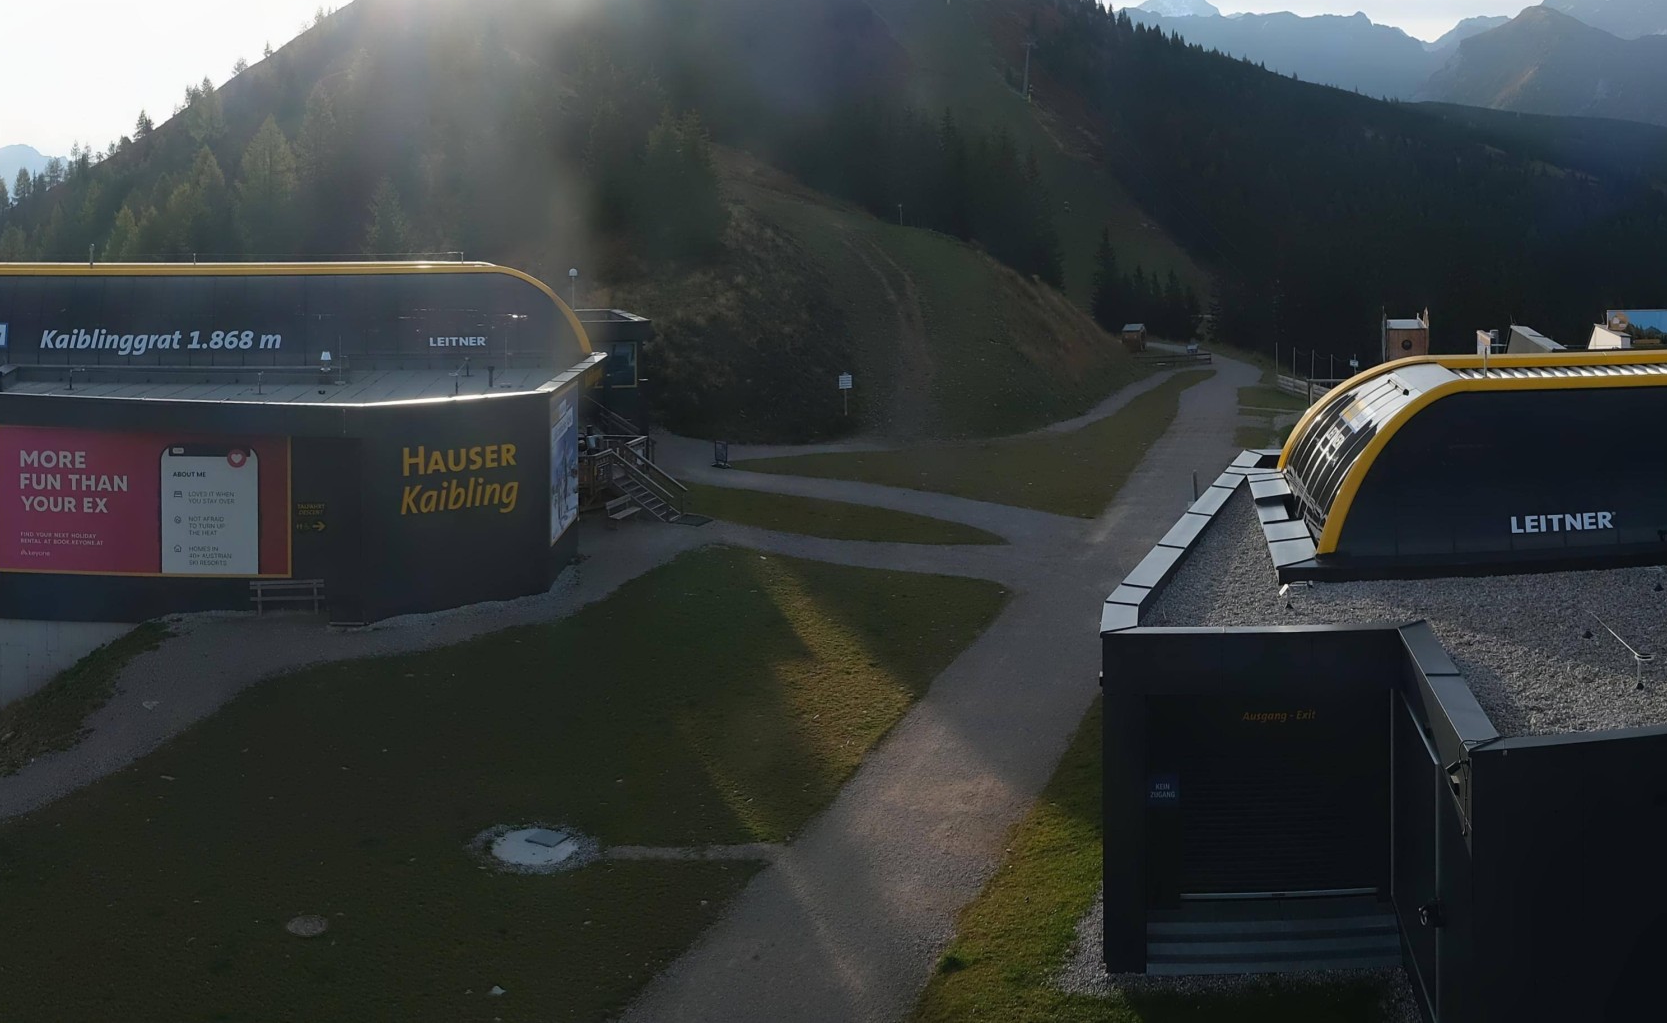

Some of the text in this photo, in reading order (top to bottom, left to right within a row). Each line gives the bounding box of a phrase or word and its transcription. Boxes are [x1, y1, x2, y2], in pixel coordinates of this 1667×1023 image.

[39, 329, 282, 356] Kaiblinggrat 1.868 m
[429, 336, 486, 347] LEITNER
[20, 450, 86, 469] MORE
[402, 443, 517, 477] HAUSER
[20, 473, 128, 492] FUN THAN
[21, 495, 108, 514] YOUR EX
[400, 477, 519, 515] Kaibling
[1510, 511, 1614, 534] LEITNER
[1242, 711, 1287, 723] Ausgang
[1296, 709, 1316, 720] Exit
